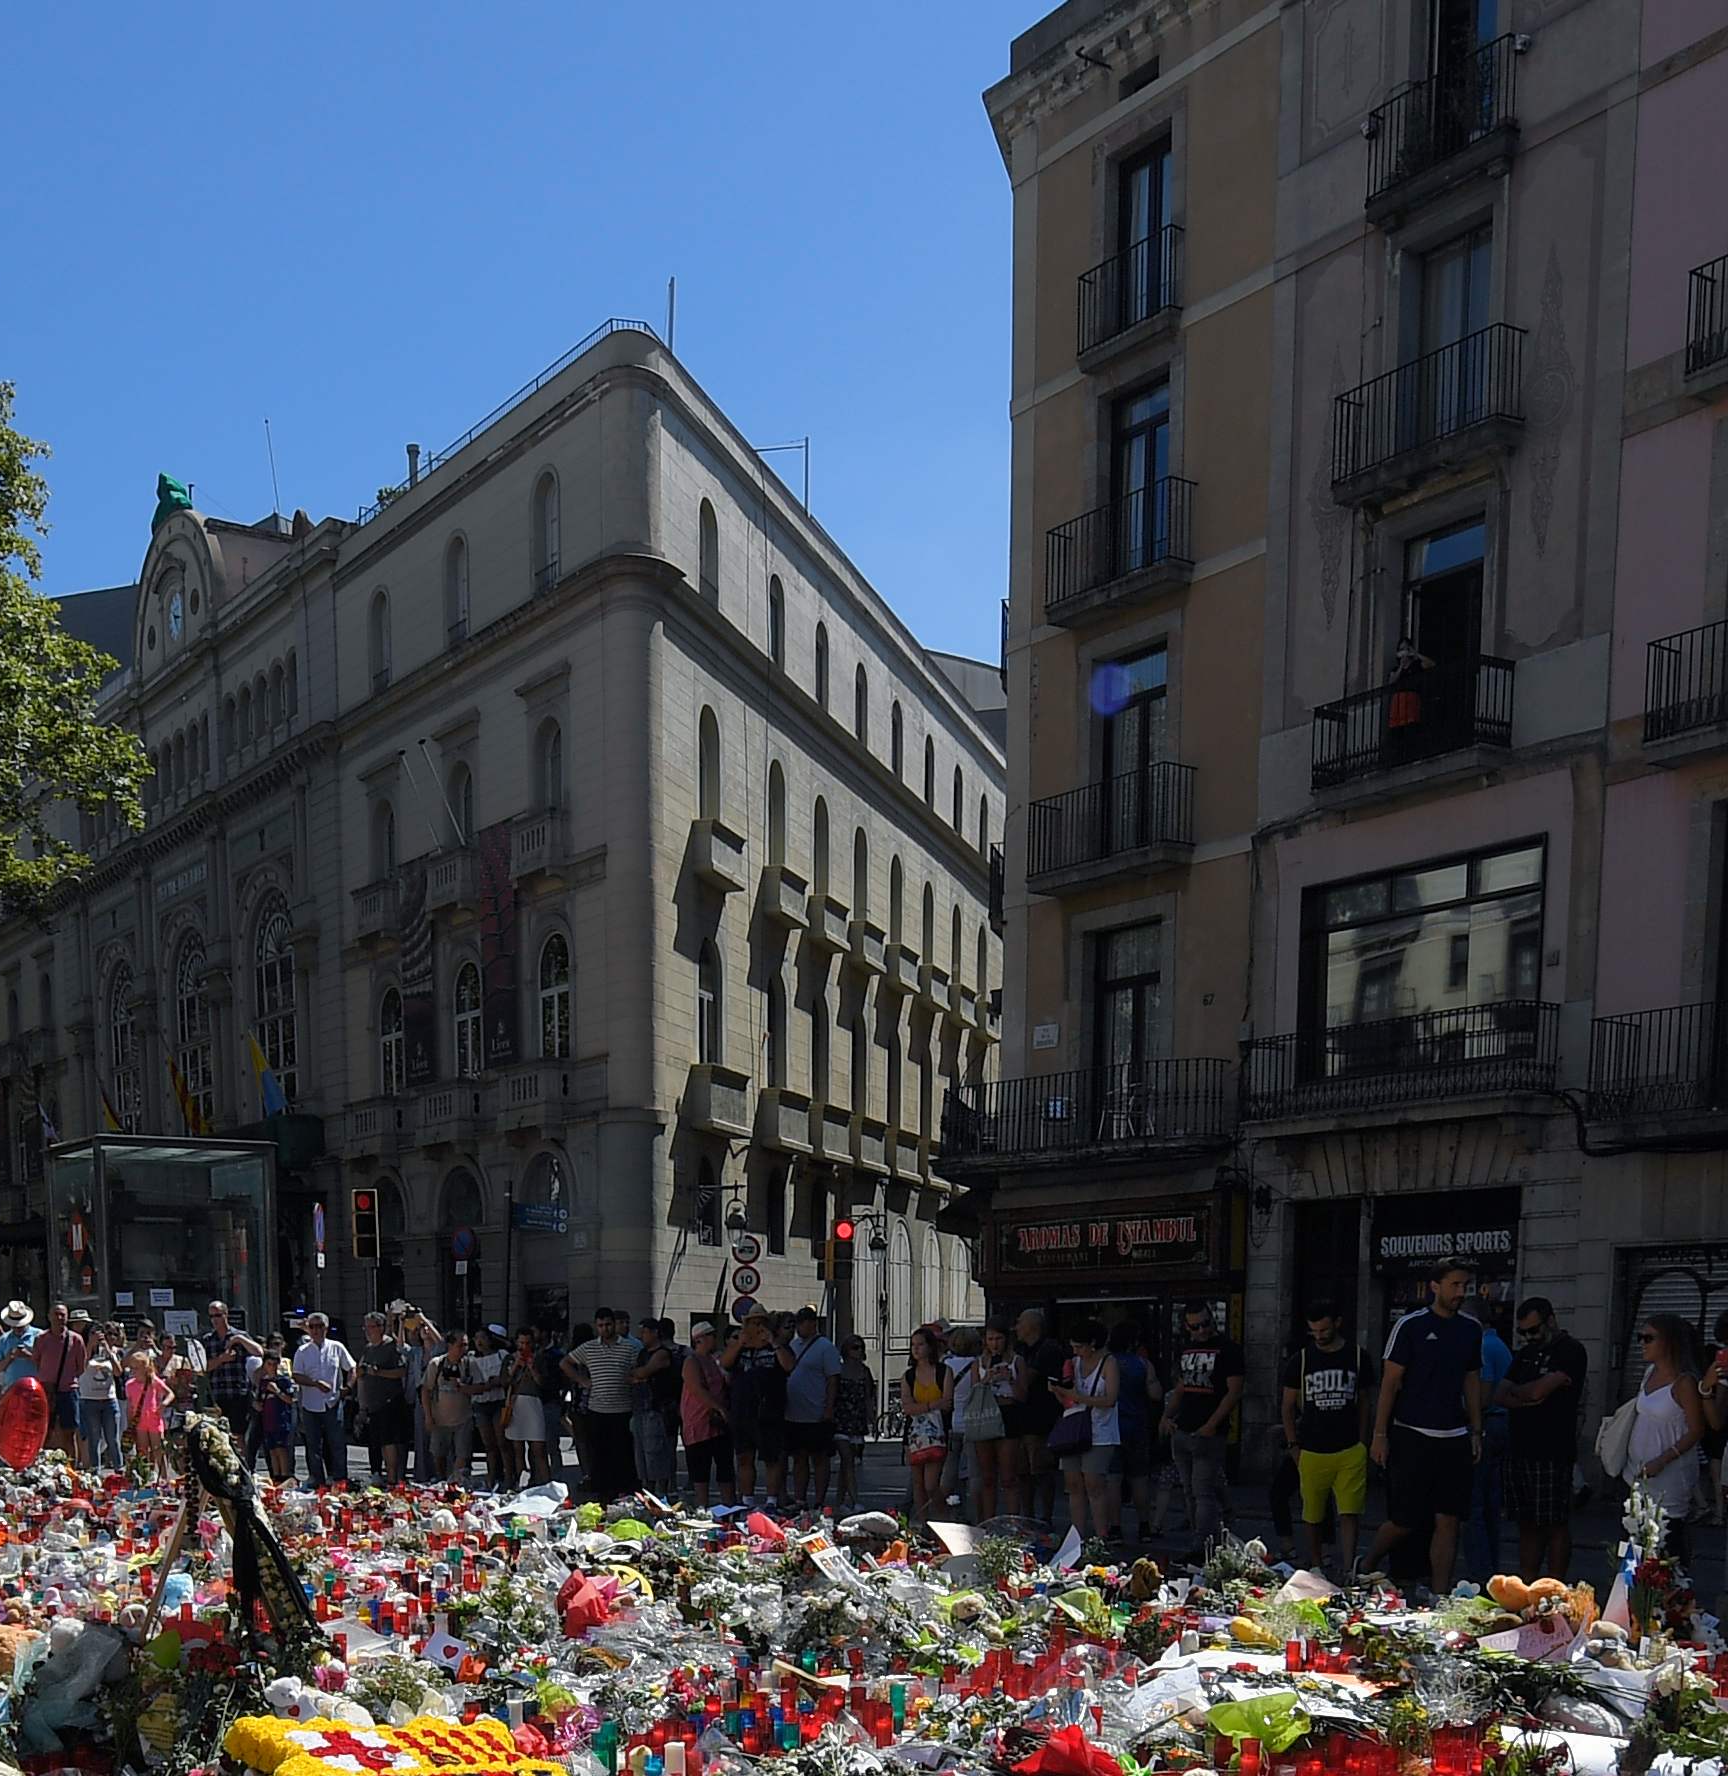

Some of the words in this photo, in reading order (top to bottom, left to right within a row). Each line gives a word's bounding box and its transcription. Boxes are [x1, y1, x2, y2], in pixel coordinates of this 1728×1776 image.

[1088, 1222, 1110, 1247] DE
[1380, 1232, 1454, 1257] SOUVENIRS
[1456, 1229, 1512, 1253] SPORTS
[740, 1275, 753, 1286] 10
